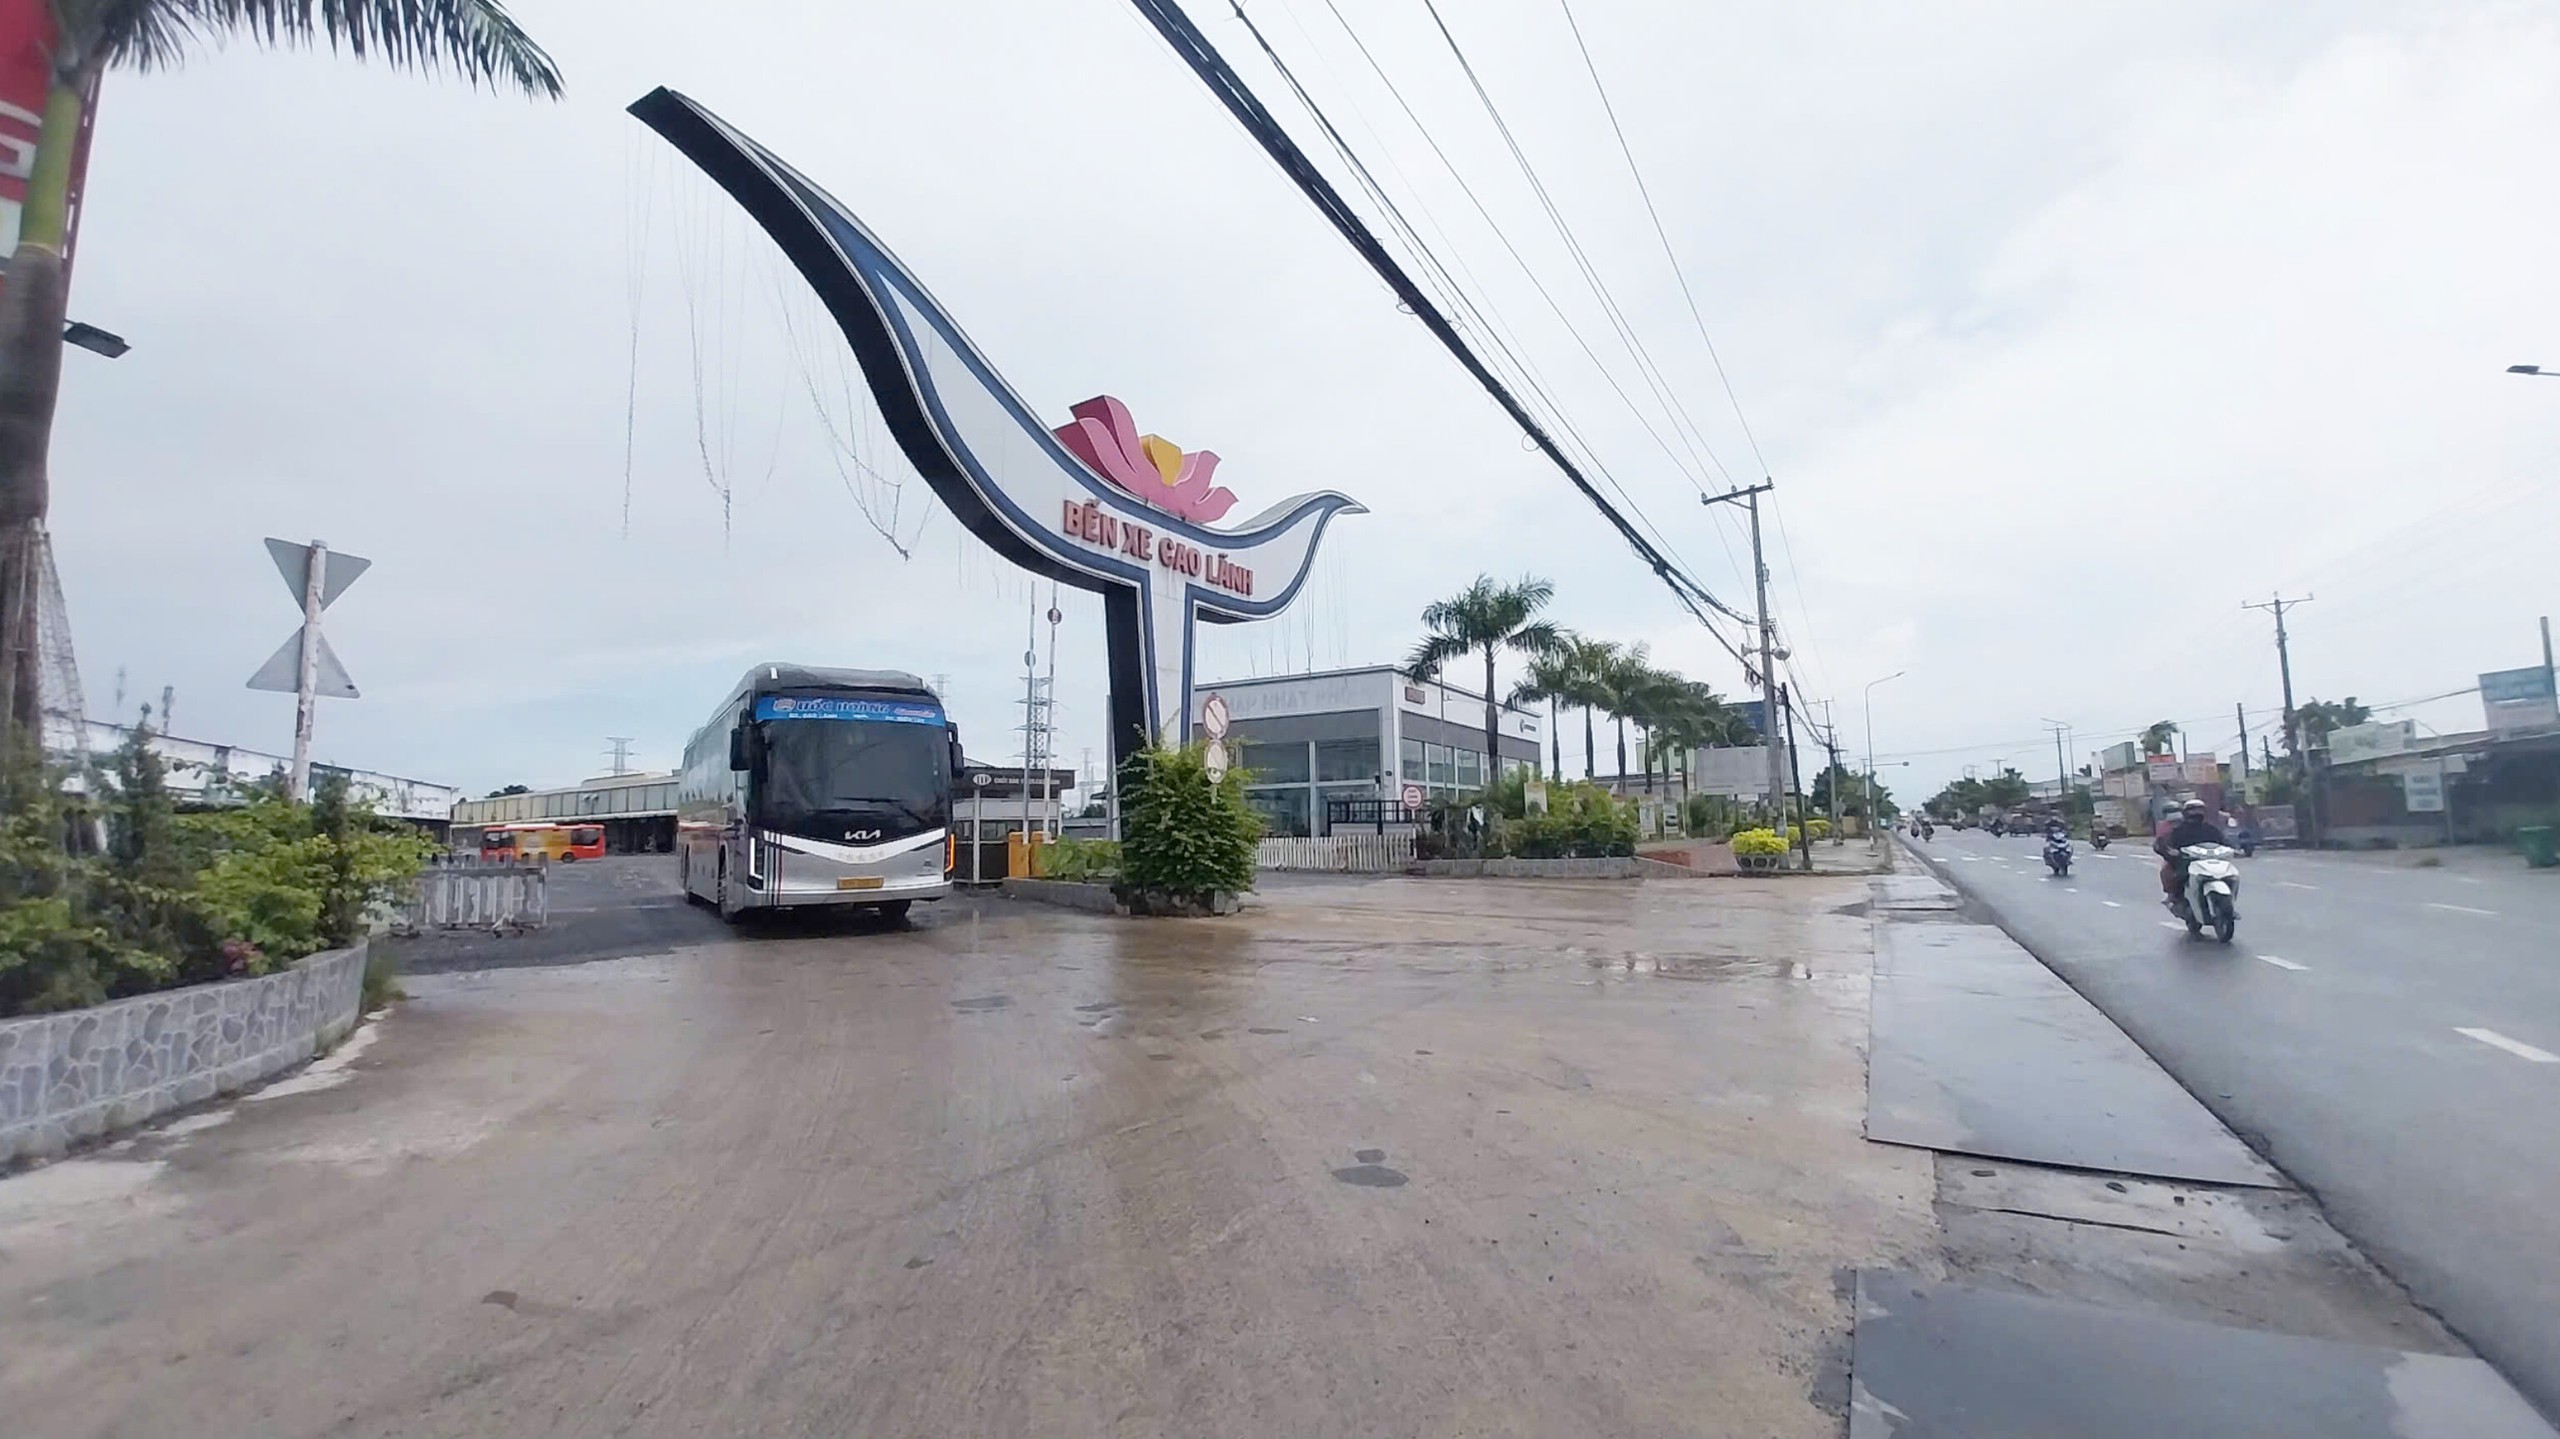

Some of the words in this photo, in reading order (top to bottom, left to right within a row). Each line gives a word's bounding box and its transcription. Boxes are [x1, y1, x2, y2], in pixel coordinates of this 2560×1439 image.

[1063, 498, 1117, 549] BẾN
[1121, 522, 1153, 561] XE
[1158, 537, 1201, 577] CAO
[1205, 552, 1254, 596] LÃNH
[845, 829, 881, 840] KIA
